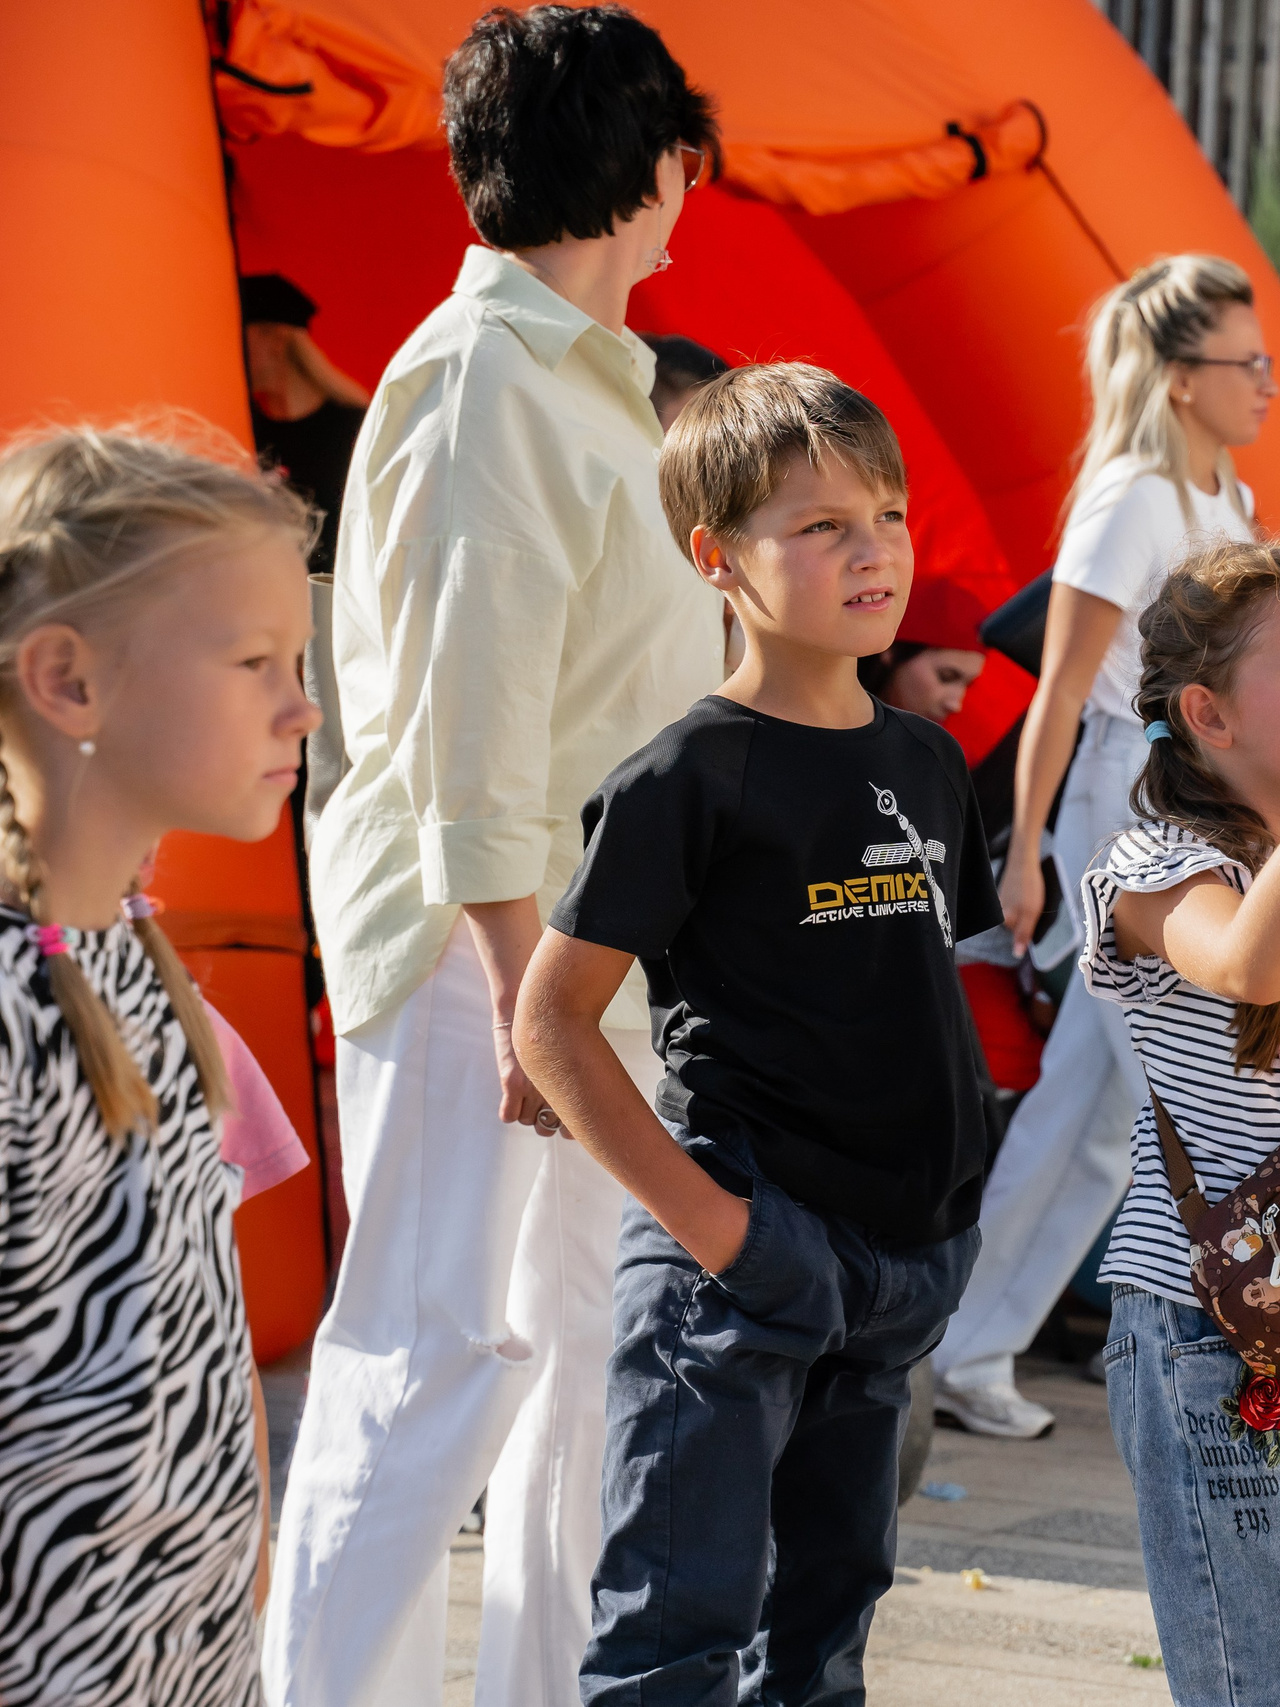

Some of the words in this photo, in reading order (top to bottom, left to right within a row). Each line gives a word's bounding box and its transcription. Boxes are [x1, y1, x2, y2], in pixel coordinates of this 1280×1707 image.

[807, 872, 929, 911] DEMIX
[799, 905, 864, 925] ACTIVE
[868, 900, 930, 917] UNIVERSE
[1184, 1406, 1233, 1443] defg
